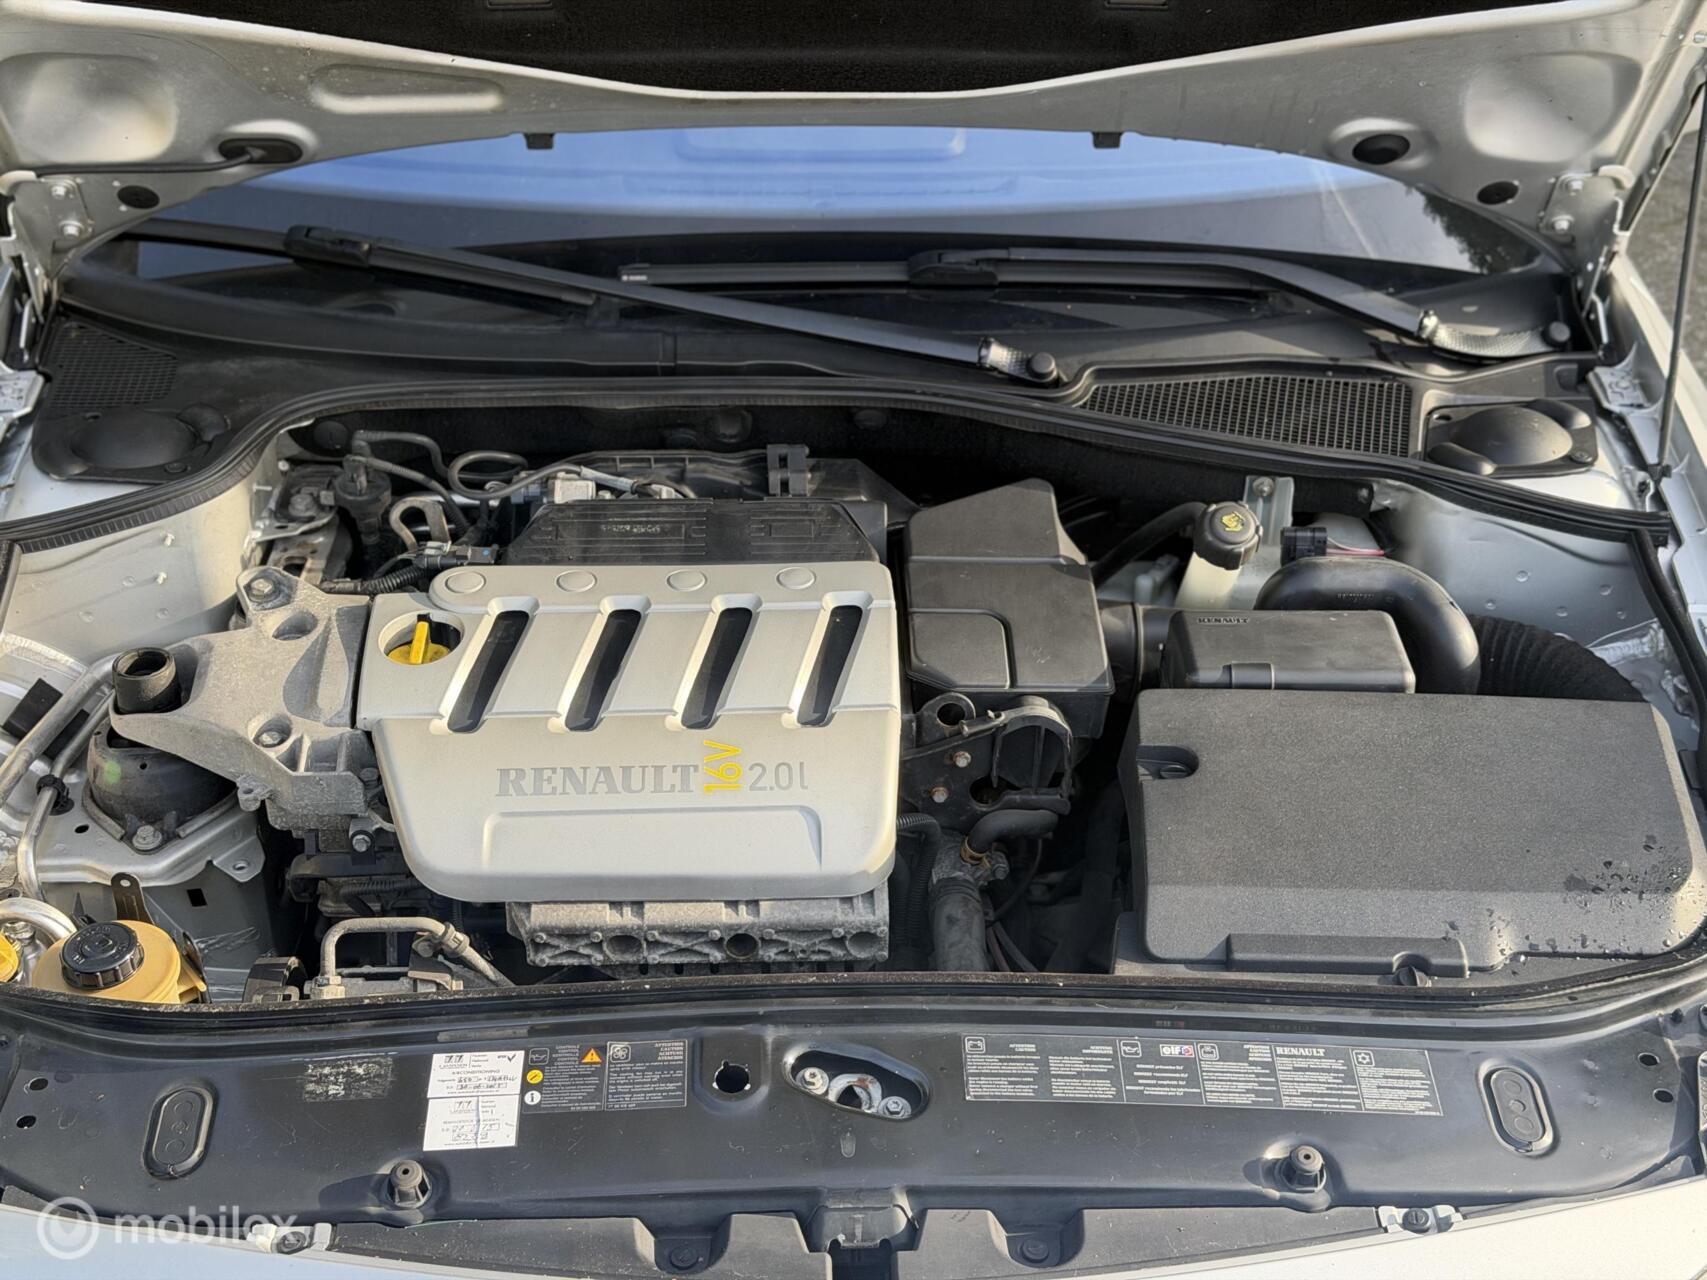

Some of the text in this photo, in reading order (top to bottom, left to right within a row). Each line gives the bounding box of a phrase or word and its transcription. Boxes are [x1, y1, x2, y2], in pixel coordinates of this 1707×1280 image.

[495, 764, 699, 797] RENAULT
[703, 740, 742, 795] 16V
[1275, 1046, 1326, 1056] RENAULT
